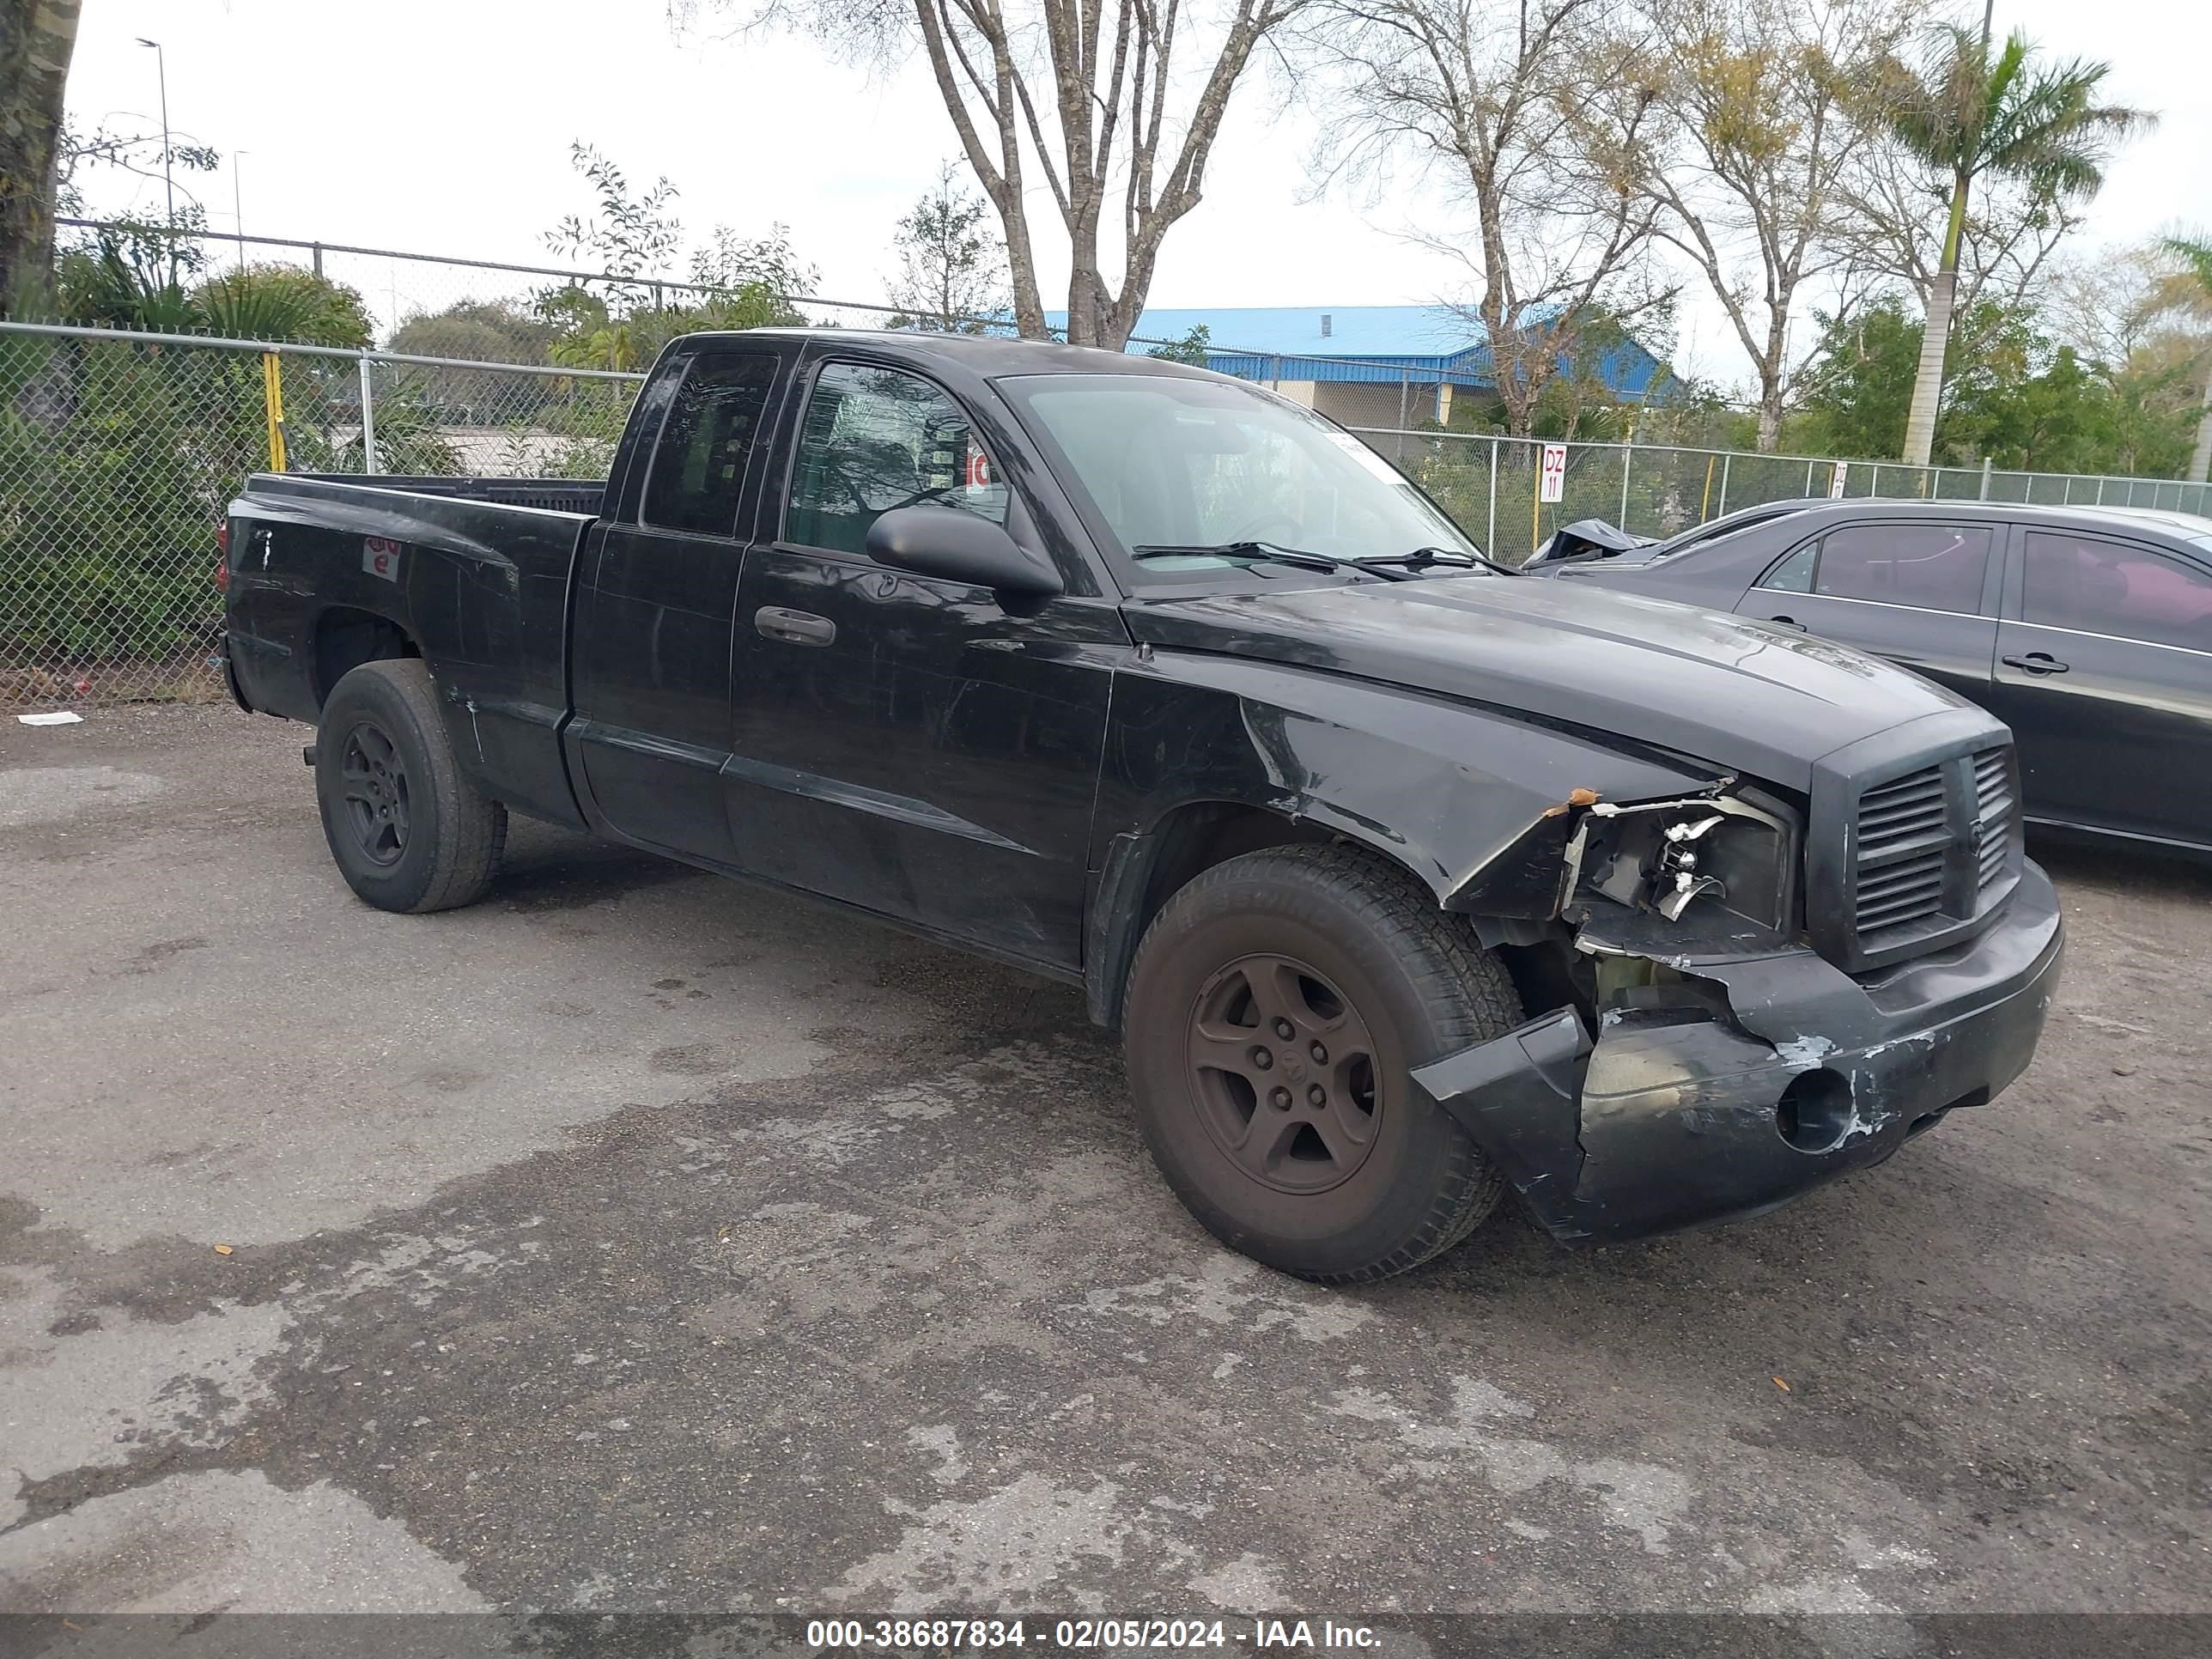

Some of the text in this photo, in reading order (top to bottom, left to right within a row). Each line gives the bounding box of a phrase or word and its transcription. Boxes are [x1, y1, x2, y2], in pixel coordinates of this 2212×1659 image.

[1545, 449, 1564, 472] DZ
[1548, 476, 1557, 497] 11
[1170, 890, 1333, 938] ROSSWIND
